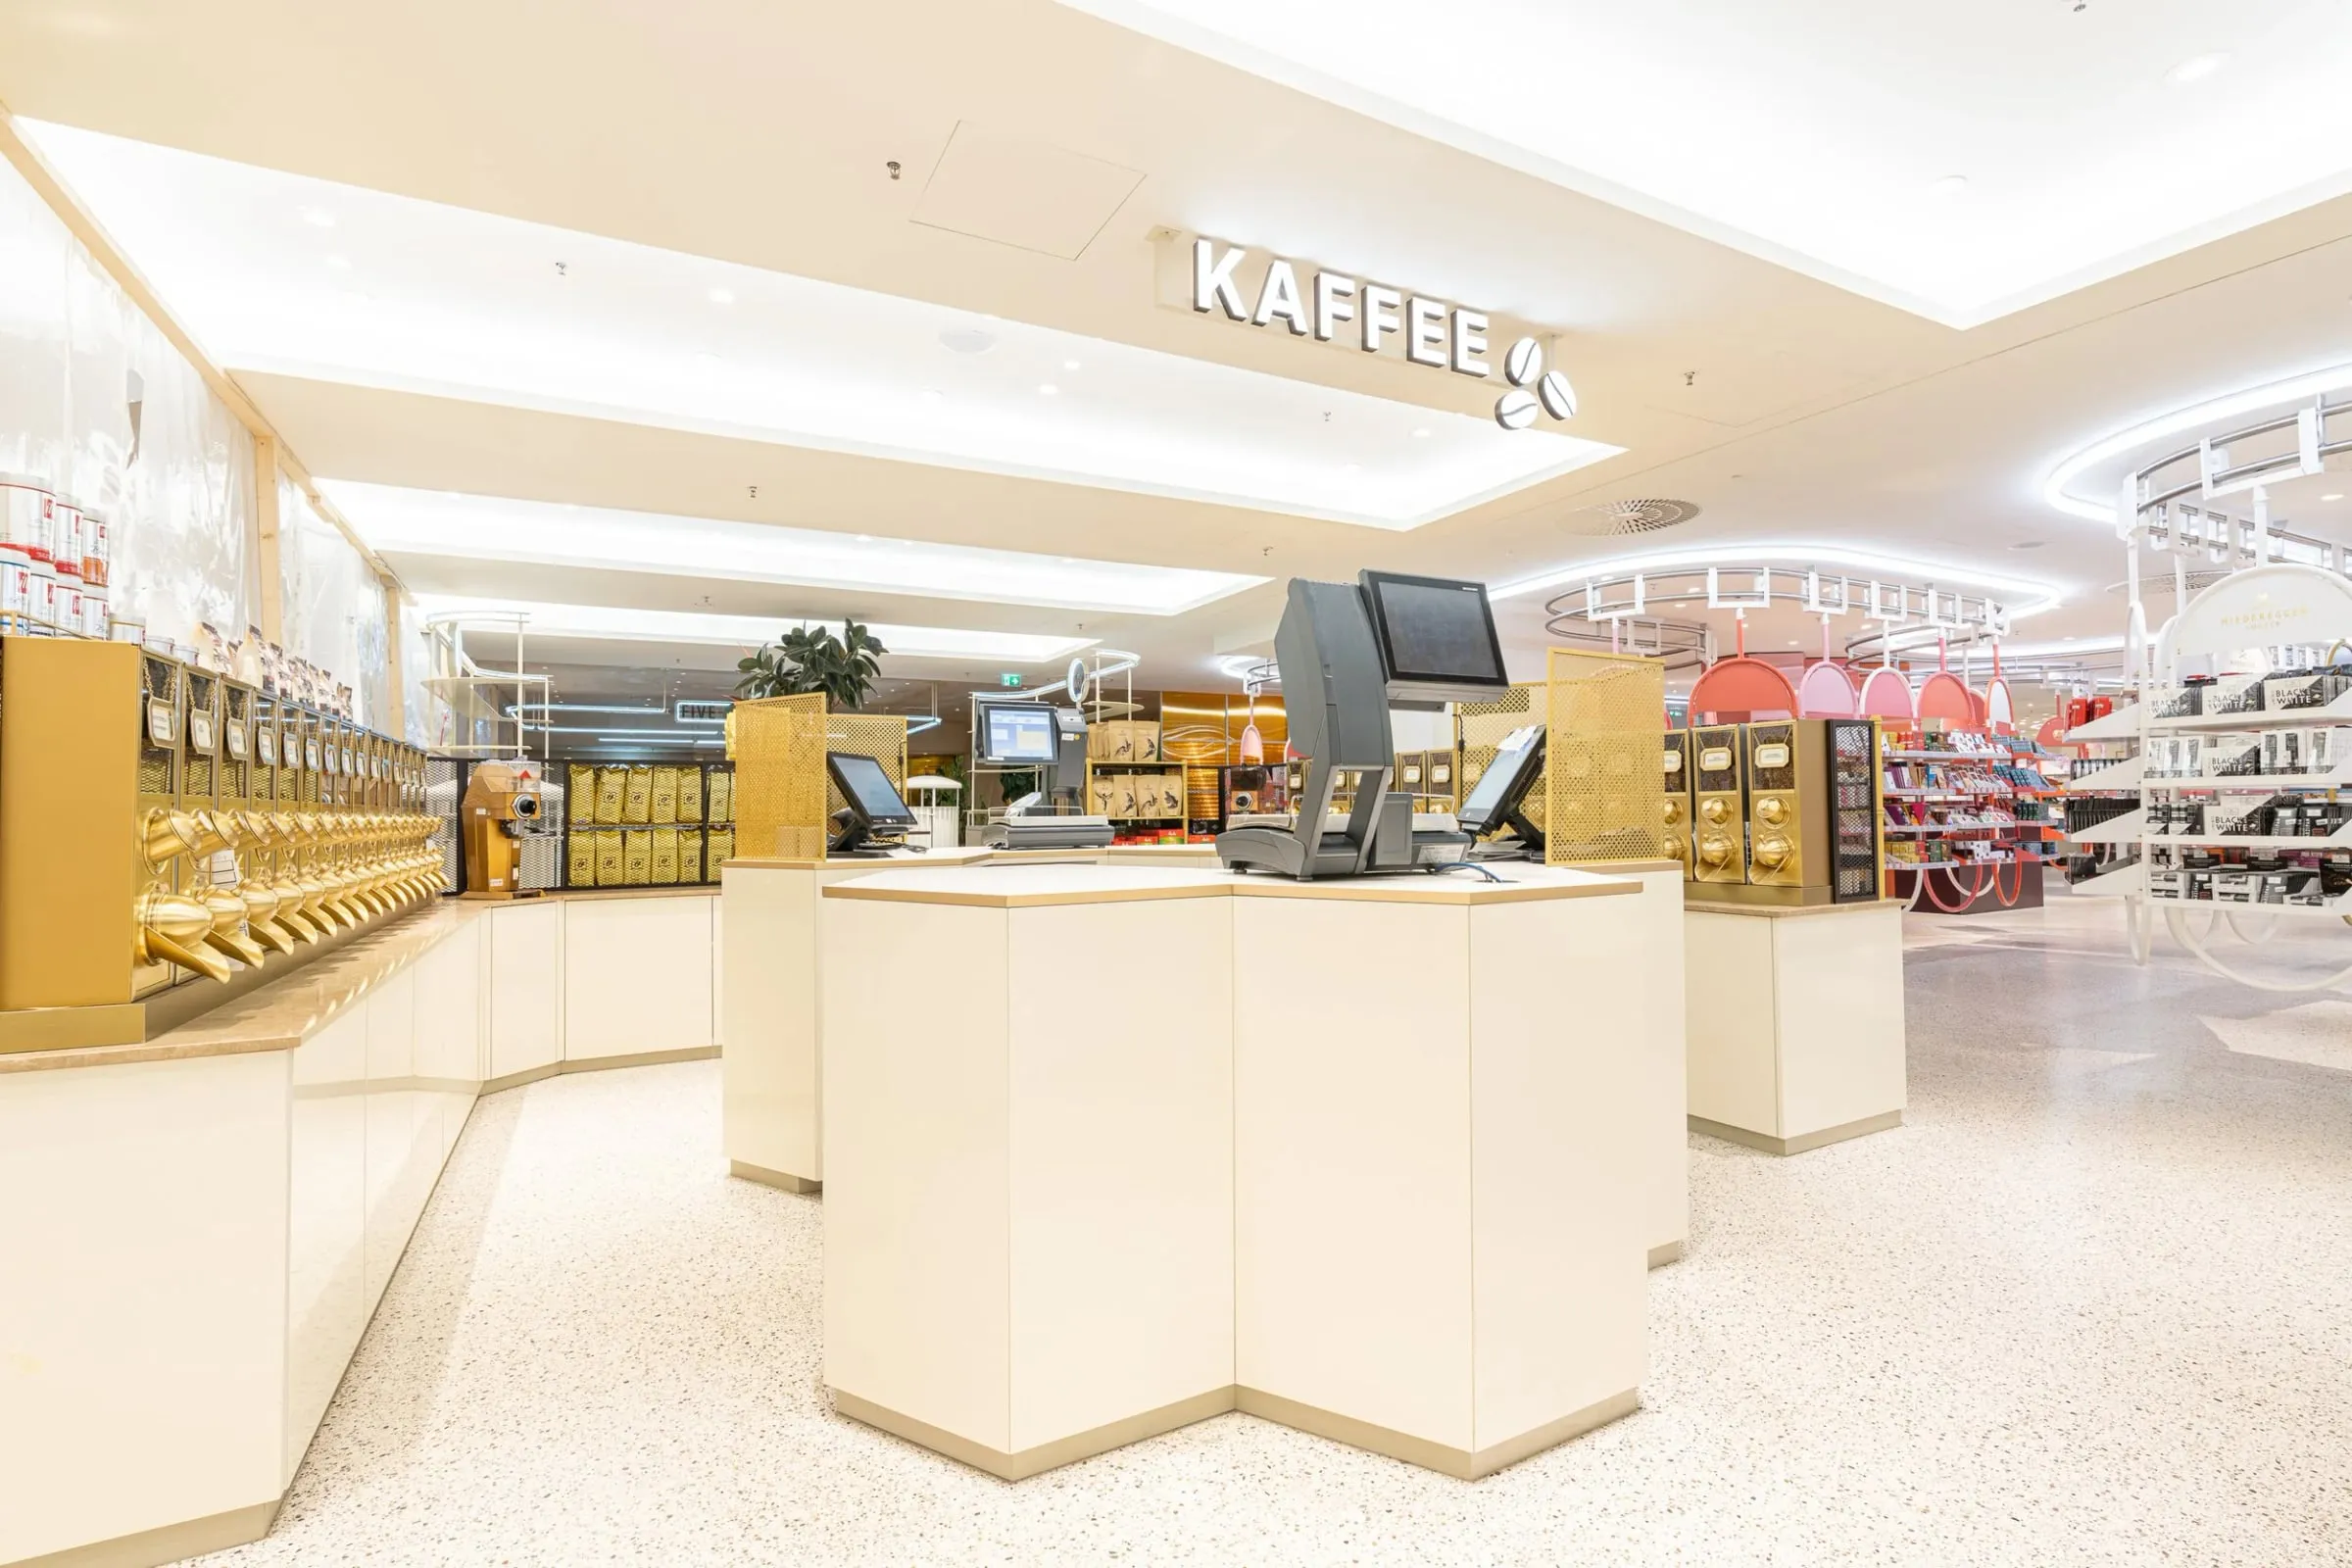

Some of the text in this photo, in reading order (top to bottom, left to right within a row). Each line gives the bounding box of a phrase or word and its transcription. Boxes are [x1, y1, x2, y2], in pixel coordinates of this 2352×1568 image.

[1193, 237, 1491, 378] KAFFEE
[2276, 688, 2306, 697] BLACK
[681, 705, 715, 719] FIVE
[2212, 757, 2238, 765] BLACK
[2215, 815, 2242, 824] BLACK
